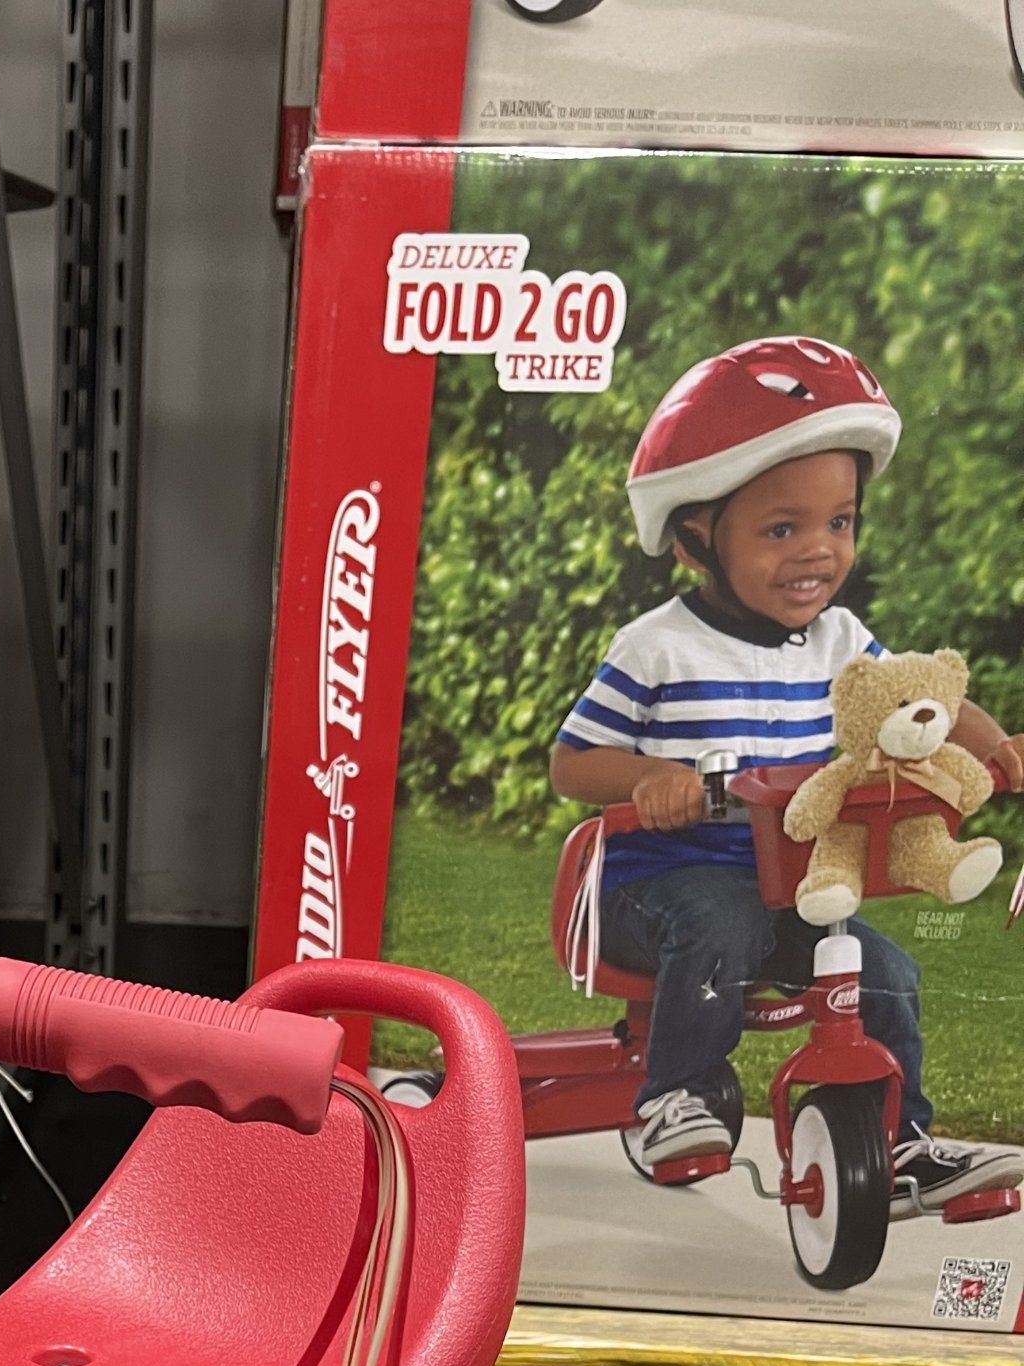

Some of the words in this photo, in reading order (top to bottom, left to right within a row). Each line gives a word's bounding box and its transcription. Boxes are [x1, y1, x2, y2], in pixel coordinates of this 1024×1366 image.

[399, 245, 518, 270] DELUXE
[395, 281, 502, 342] FOLD
[515, 282, 542, 342] 2
[554, 282, 616, 344] GO
[506, 354, 603, 380] TRIKE
[325, 488, 381, 742] FLYER
[295, 830, 335, 964] DIO
